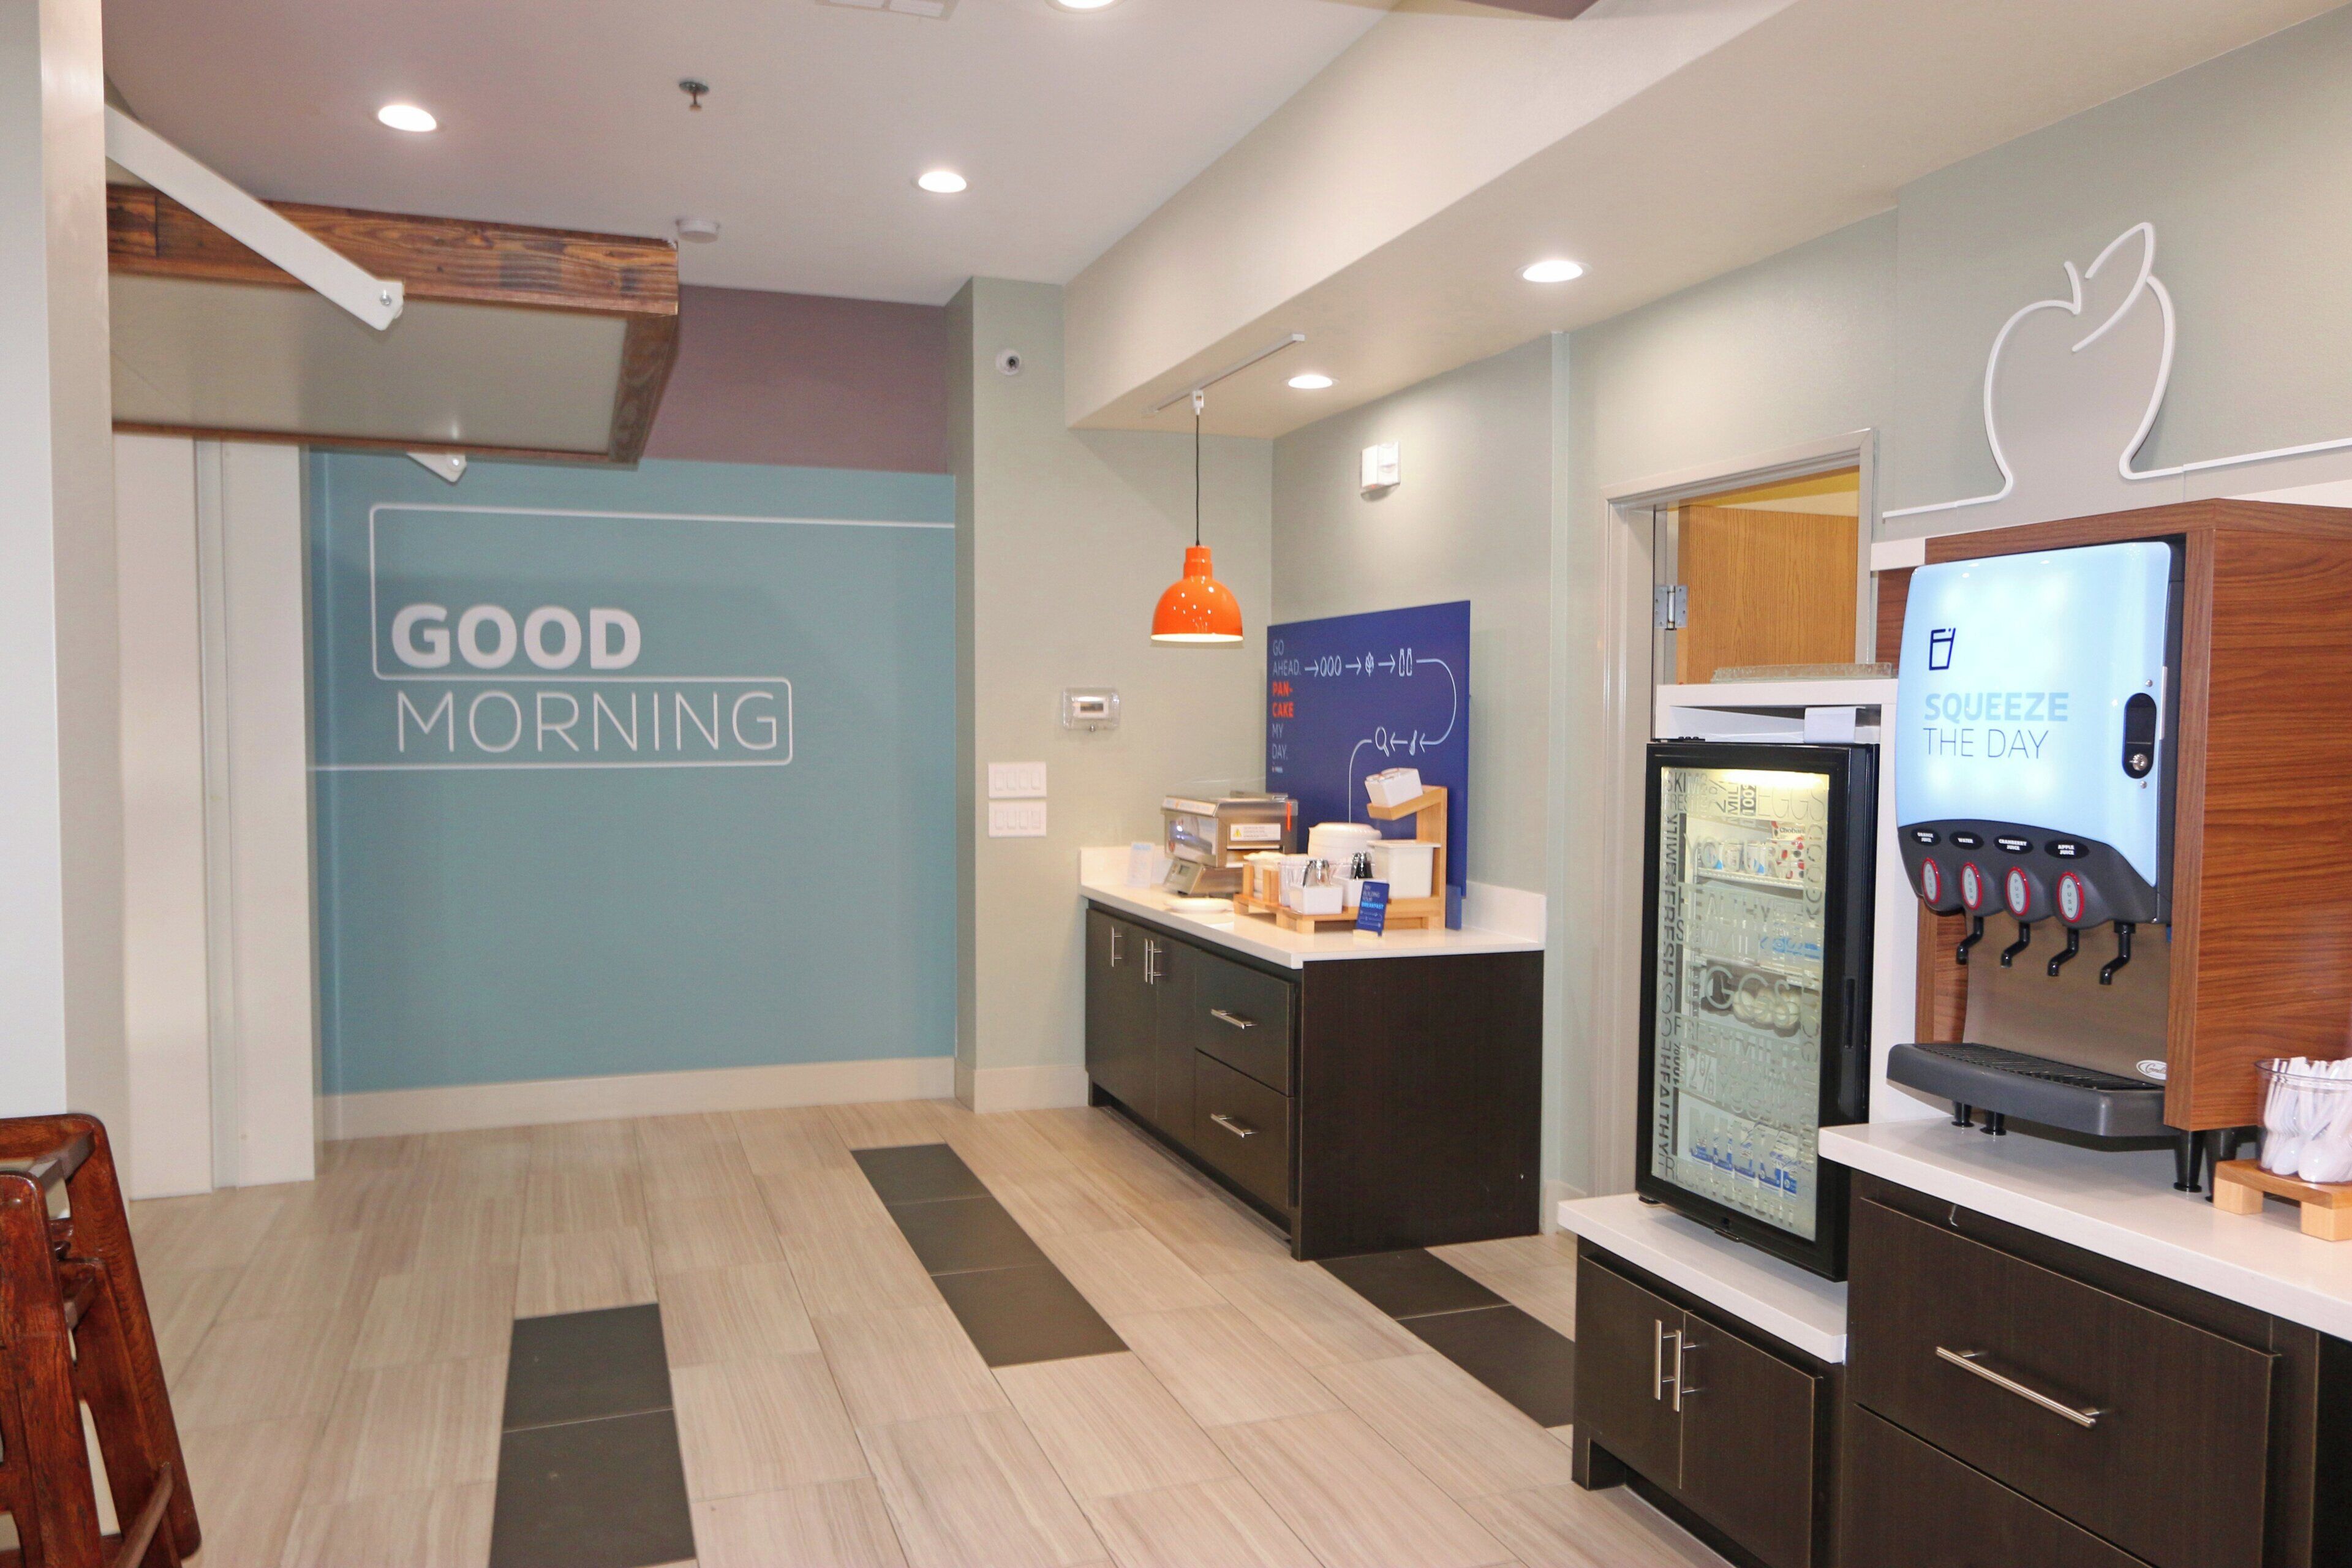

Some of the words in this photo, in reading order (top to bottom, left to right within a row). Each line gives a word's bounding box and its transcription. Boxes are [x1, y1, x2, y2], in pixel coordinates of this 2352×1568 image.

[391, 603, 641, 669] GOOD
[1273, 639, 1284, 656] GO
[1273, 659, 1302, 676] AHEAD.
[1272, 681, 1294, 696] PAN-
[1272, 702, 1294, 718] CAKE
[1924, 692, 2069, 724] SQUEEZE
[397, 690, 778, 753] MORNING
[1272, 723, 1284, 739] MY
[1272, 743, 1288, 760] DAY.
[1923, 728, 1975, 757] THE
[1988, 729, 2049, 760] DAY
